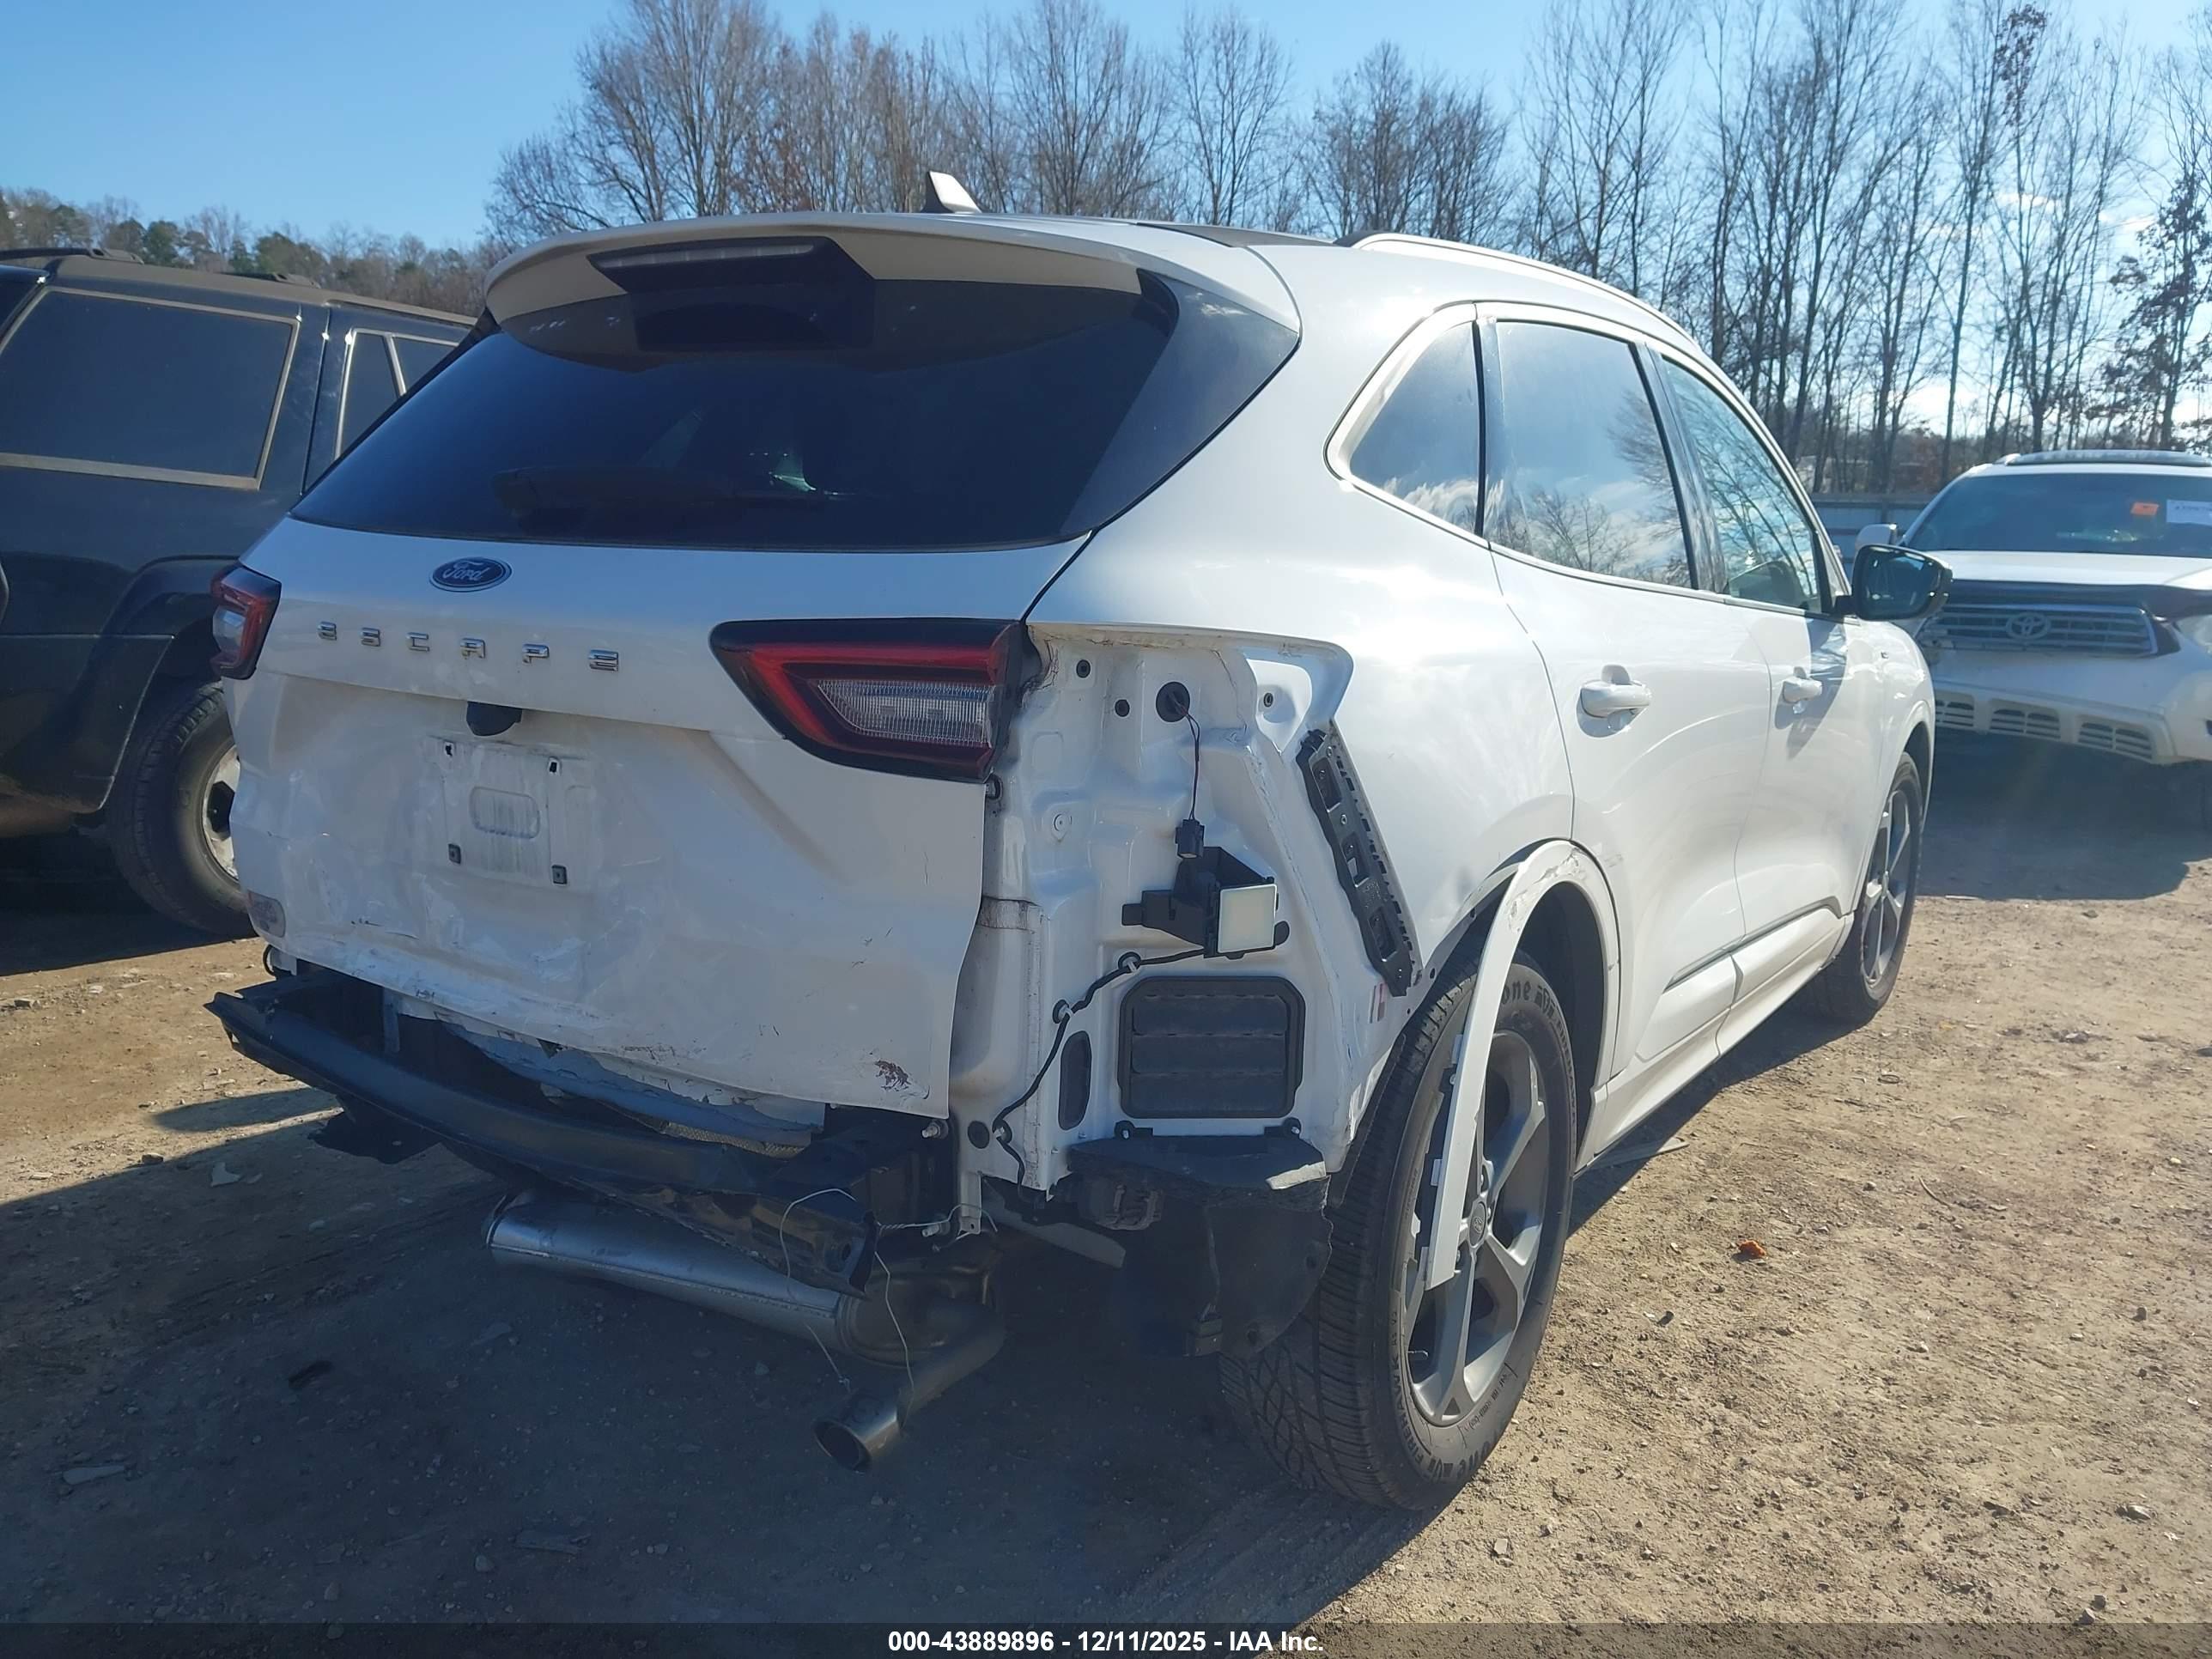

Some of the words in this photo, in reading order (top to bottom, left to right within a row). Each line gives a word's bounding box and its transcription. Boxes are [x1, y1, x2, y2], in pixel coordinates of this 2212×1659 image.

[442, 560, 490, 581] Ford
[317, 621, 619, 672] ESCAPE
[1391, 1355, 1425, 1465] FIREHAWK
